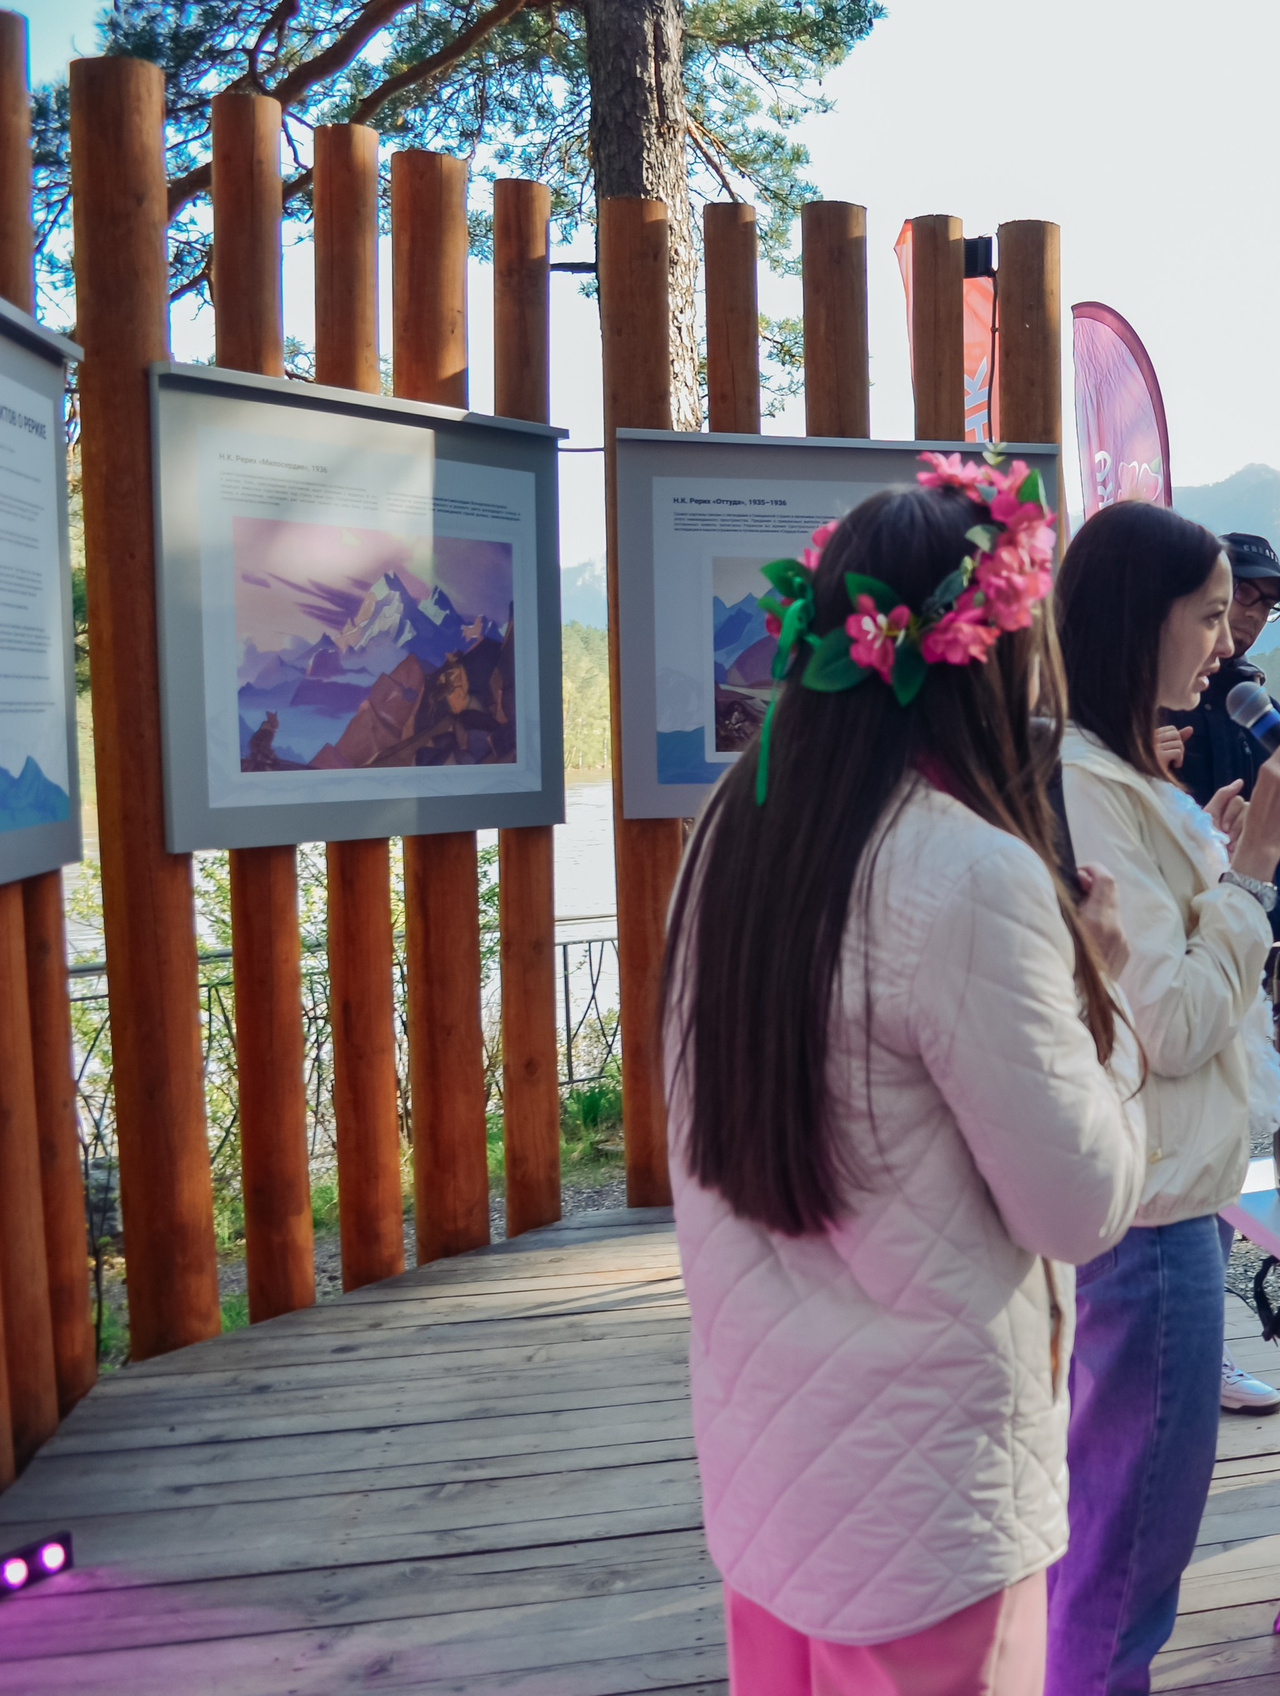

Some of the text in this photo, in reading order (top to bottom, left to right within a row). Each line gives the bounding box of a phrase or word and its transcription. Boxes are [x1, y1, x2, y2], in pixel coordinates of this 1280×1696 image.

[235, 455, 257, 465] Рерих
[312, 465, 328, 474] 1936
[689, 497, 711, 506] Рерих
[712, 498, 747, 506] «Оттуда»,
